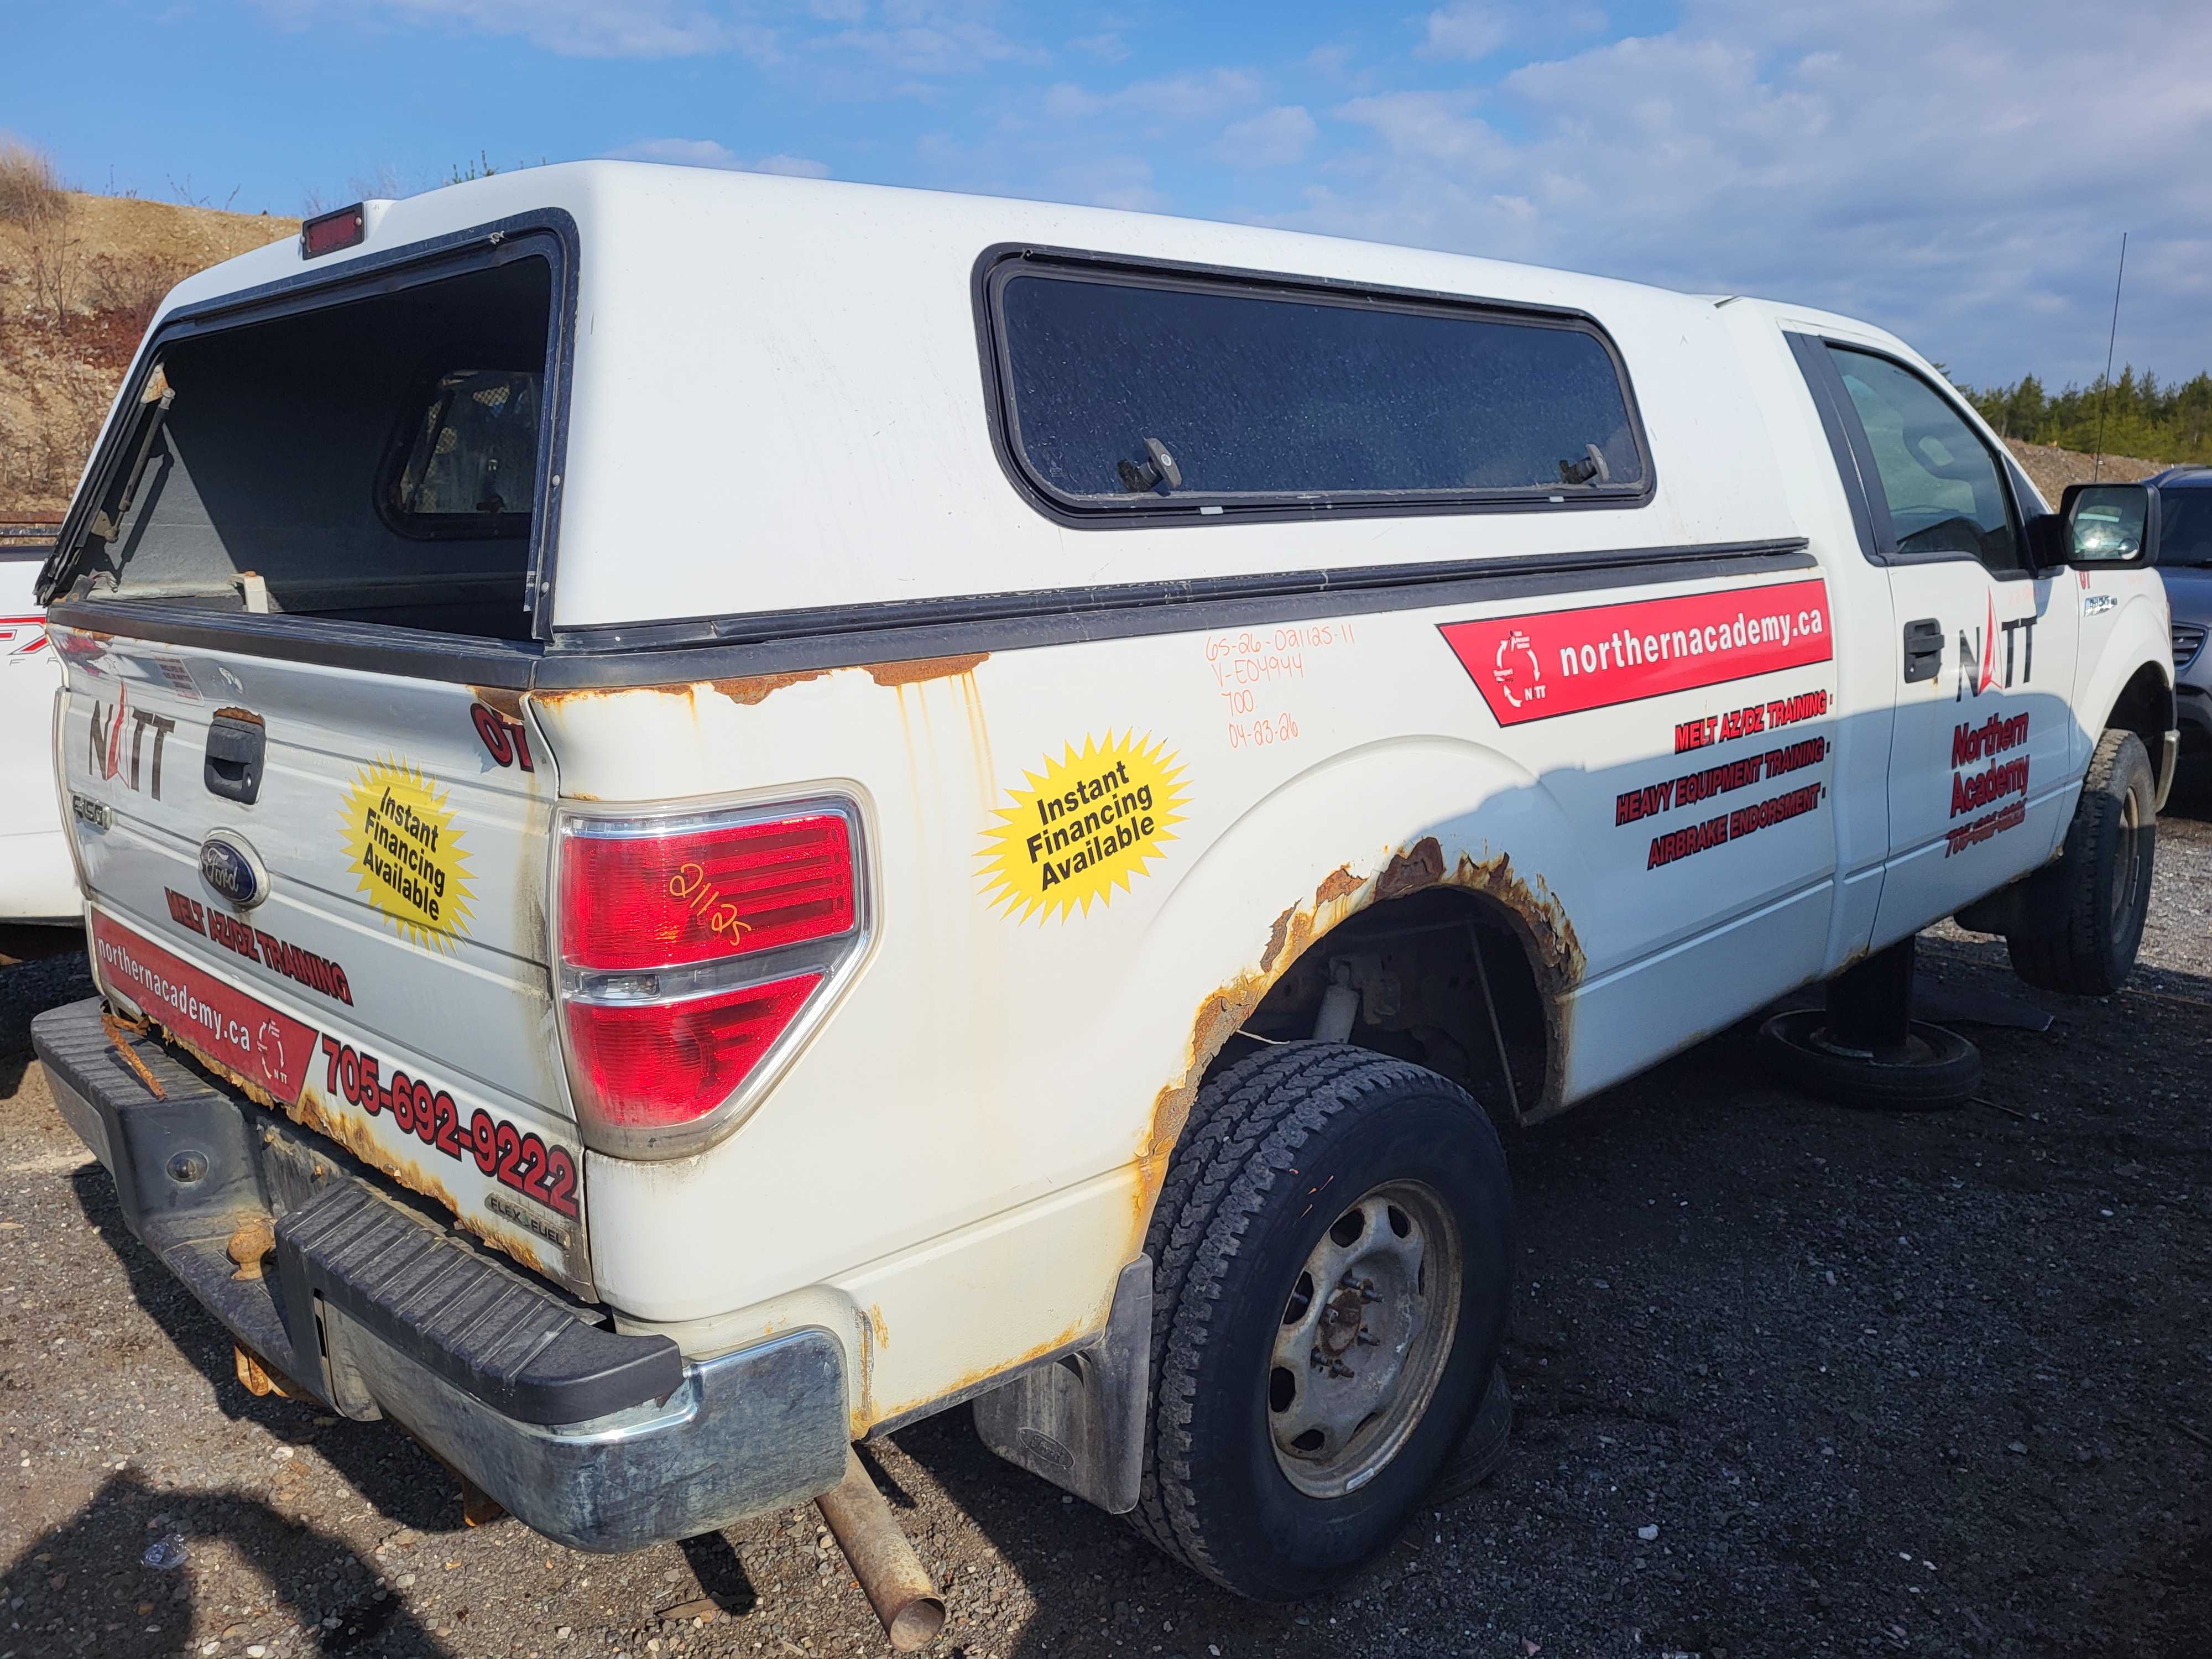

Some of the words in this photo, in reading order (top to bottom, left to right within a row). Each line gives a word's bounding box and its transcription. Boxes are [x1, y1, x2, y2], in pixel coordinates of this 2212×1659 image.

[1561, 607, 1823, 677] northernacademy.ca
[1221, 690, 1254, 716] 700
[1229, 713, 1298, 748] 04-23-26
[1674, 715, 1718, 755] MELT
[1719, 704, 1765, 743] AZ/DZ
[1767, 689, 1827, 729] TRAINING
[1952, 712, 2030, 770] Northern
[1037, 760, 1130, 826] Instant
[1615, 779, 1675, 827] HEAVY
[1674, 754, 1764, 807] EQUIPMENT
[1764, 736, 1825, 779] TRAINING
[1950, 754, 2030, 819] Academy
[364, 807, 446, 898] Financing
[380, 786, 439, 853] Instant
[1026, 784, 1153, 864] Financing
[1042, 816, 1155, 892] Available
[1647, 814, 1729, 871] AIRBRAKE
[1730, 782, 1822, 840] ENDORSMENT
[206, 847, 239, 893] Ford
[363, 843, 440, 921] Available
[164, 886, 207, 938] MELT
[254, 928, 354, 1007] TRAINING
[97, 937, 250, 1052] northernacademy.ca
[322, 1032, 580, 1220] 705-692-9222
[491, 1198, 523, 1224] FLEX
[531, 1219, 562, 1247] FUEL
